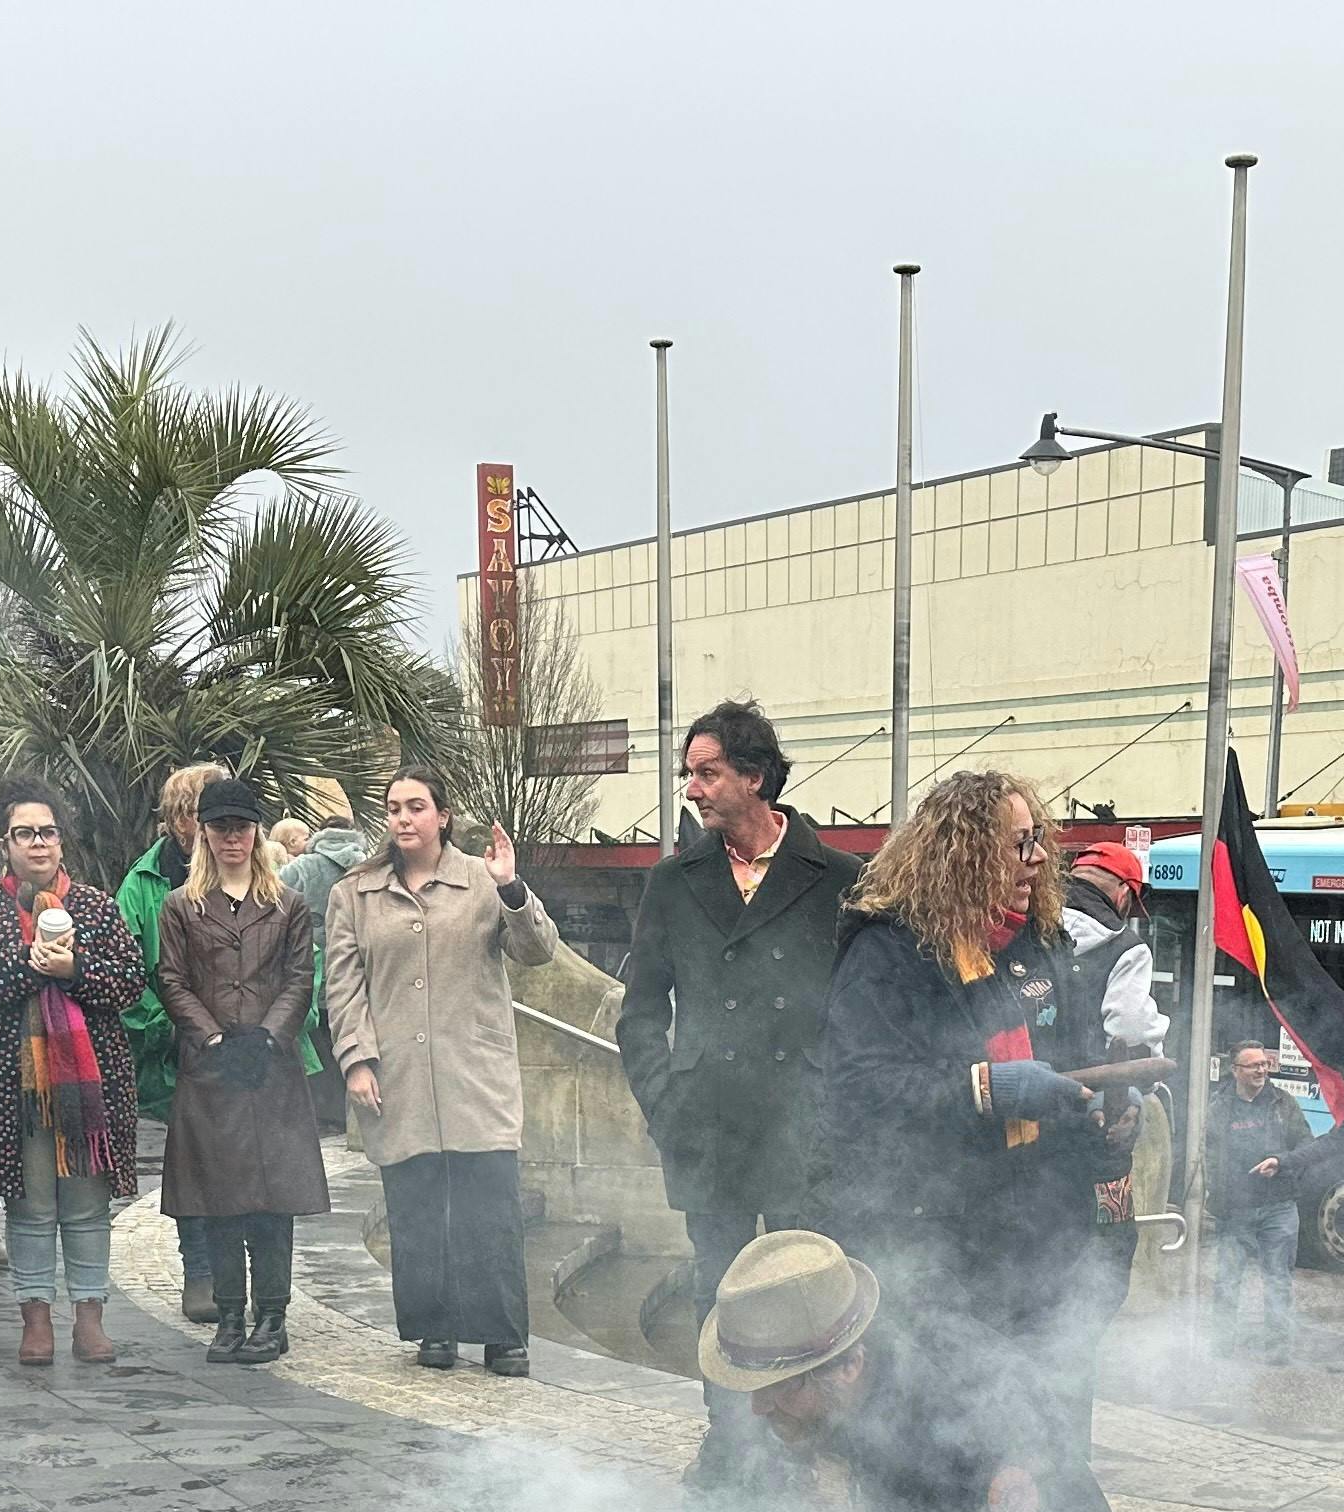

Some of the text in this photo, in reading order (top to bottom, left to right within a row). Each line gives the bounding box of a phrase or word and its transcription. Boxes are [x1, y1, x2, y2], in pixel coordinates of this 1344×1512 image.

[486, 498, 516, 691] SAVOY
[1154, 864, 1184, 881] 6890
[1309, 919, 1332, 944] NOT
